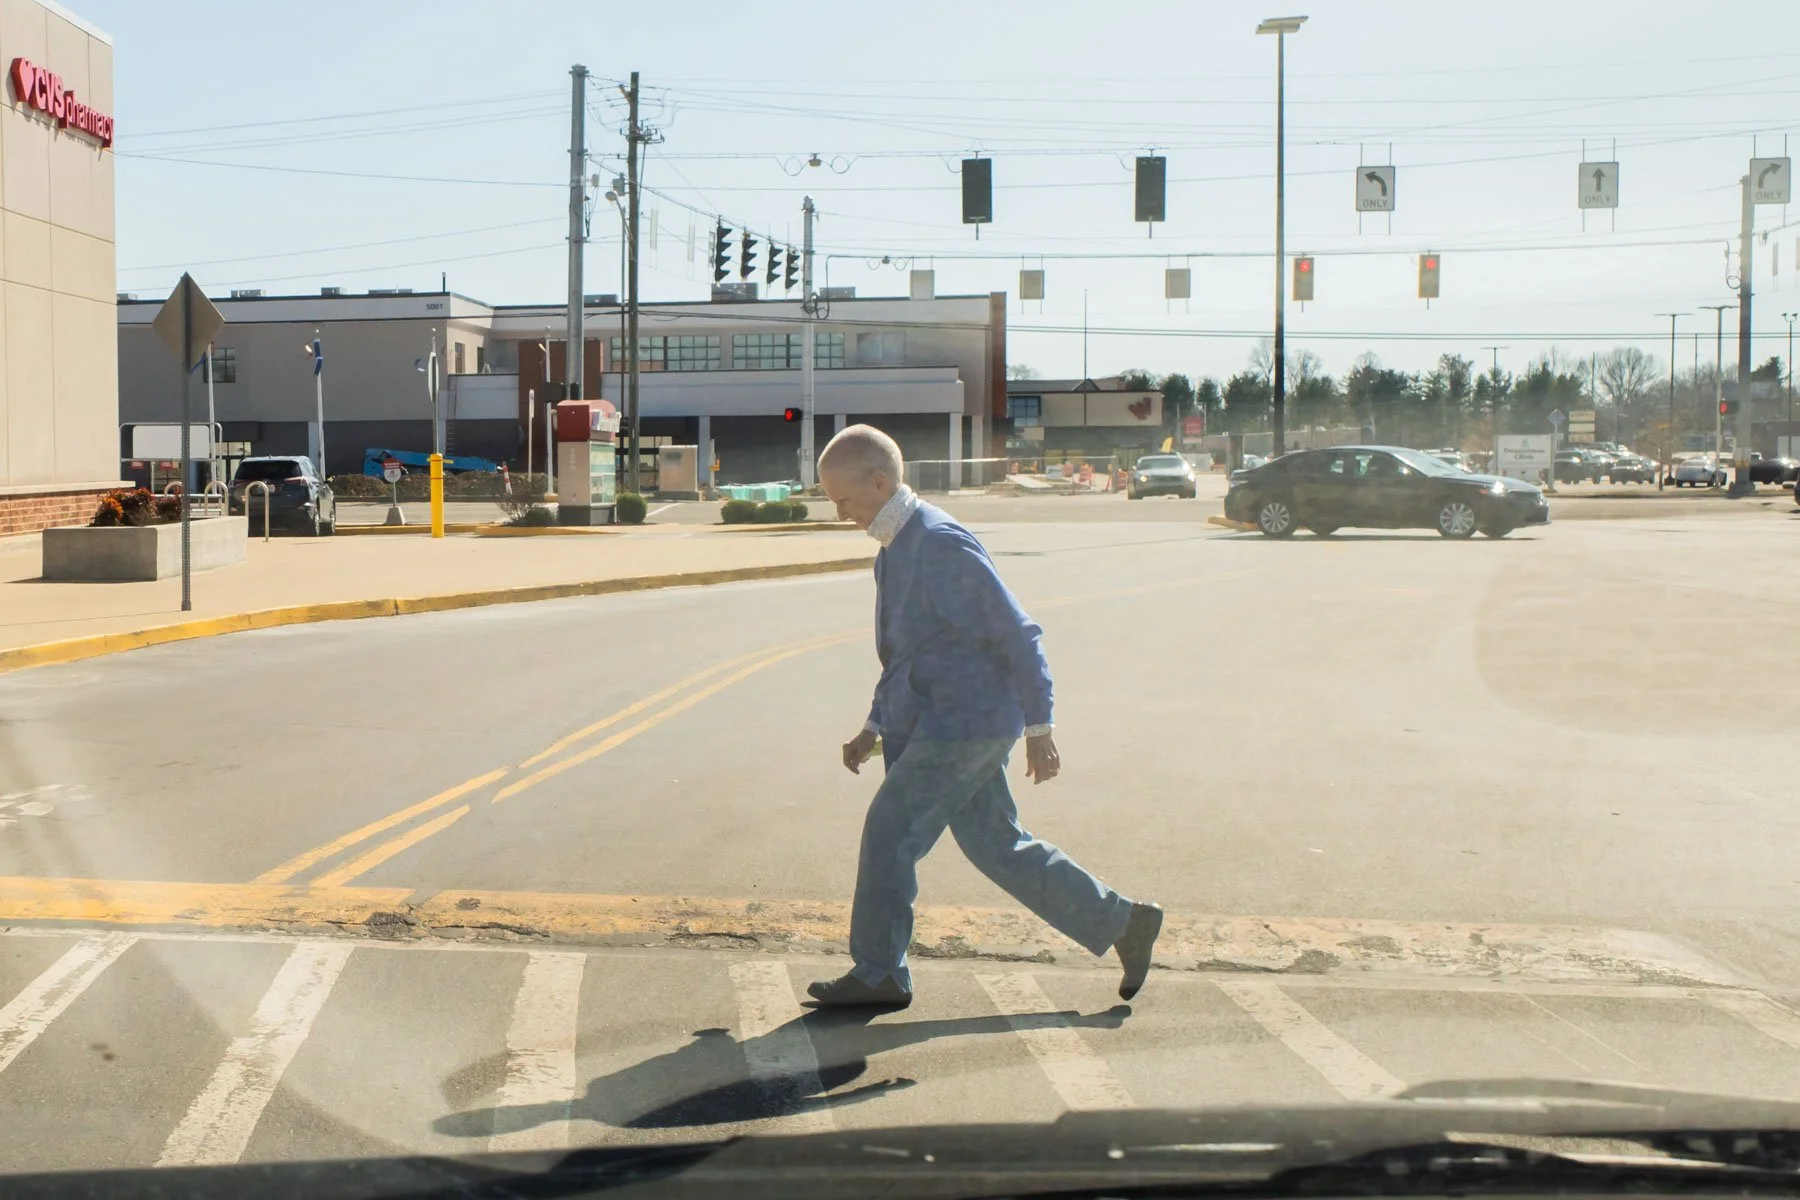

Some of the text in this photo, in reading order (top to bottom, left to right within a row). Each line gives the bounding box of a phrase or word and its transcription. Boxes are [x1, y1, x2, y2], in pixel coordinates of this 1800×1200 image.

[33, 64, 114, 148] CVS pharmacy
[1584, 195, 1611, 204] ONLY
[1756, 191, 1782, 200] ONLY
[1362, 199, 1388, 208] ONLY
